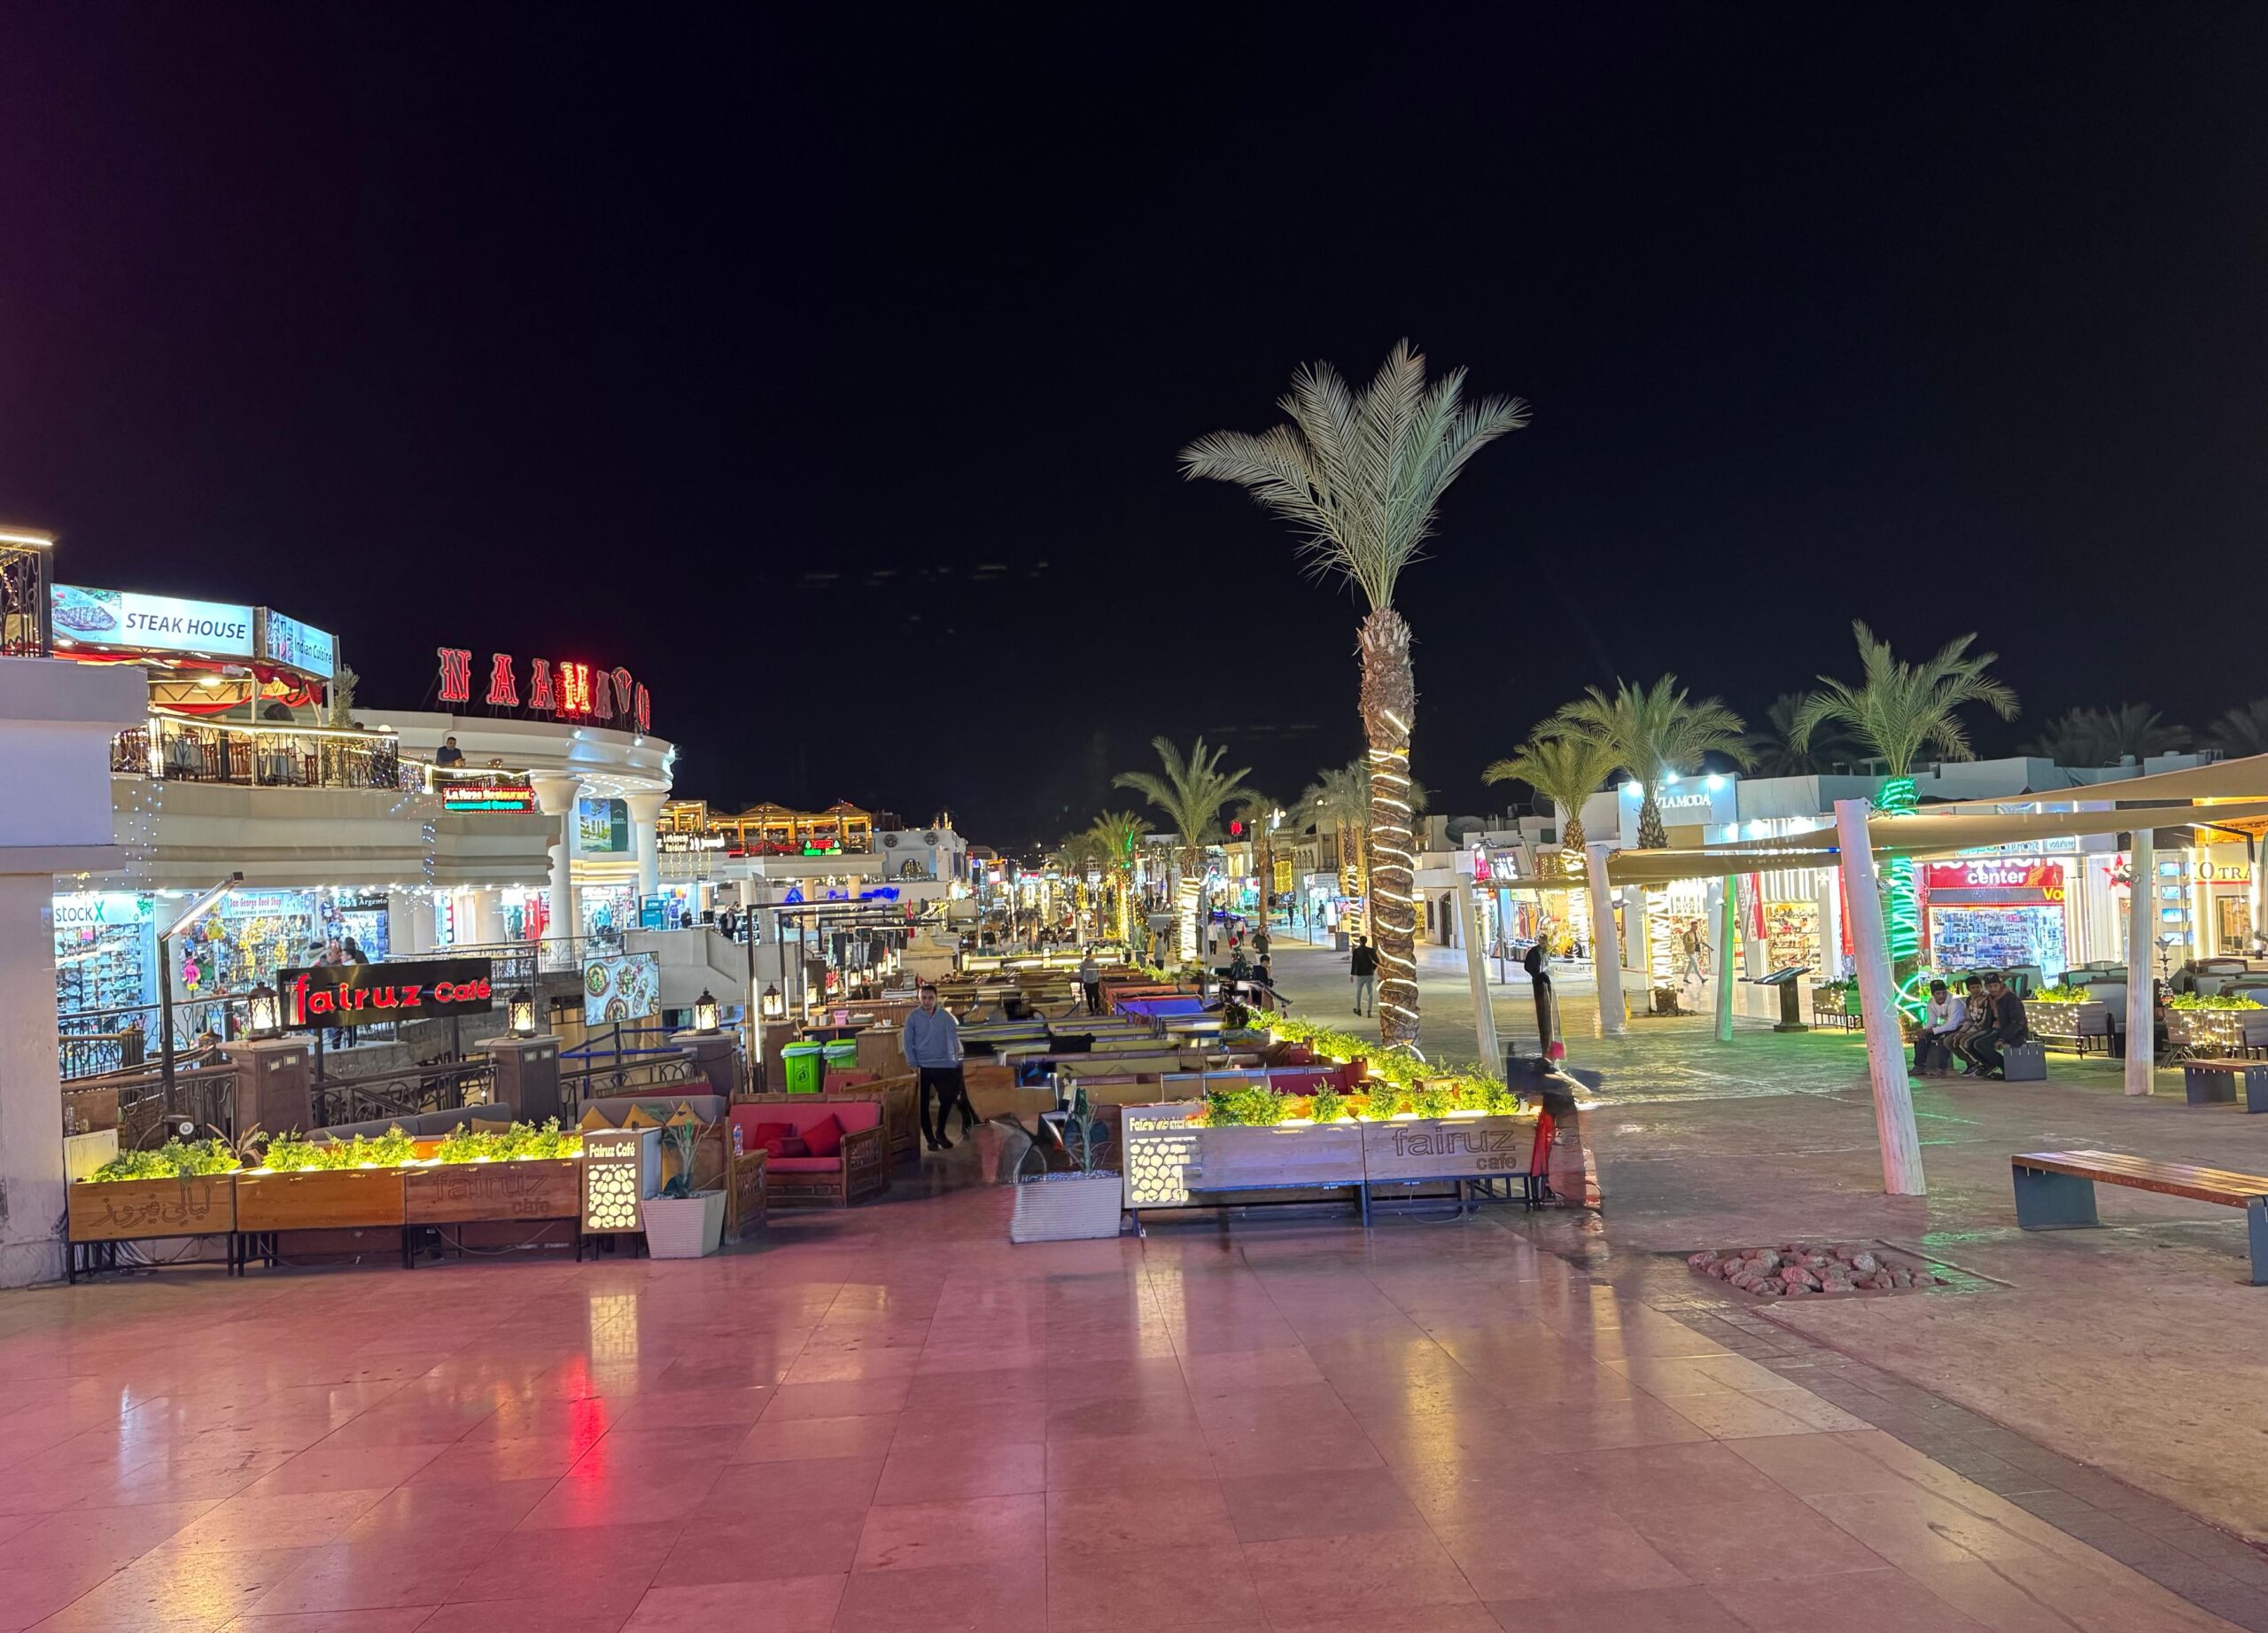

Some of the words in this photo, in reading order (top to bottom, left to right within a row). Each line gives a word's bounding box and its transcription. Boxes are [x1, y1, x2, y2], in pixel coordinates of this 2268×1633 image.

[126, 612, 183, 634] STEAK
[187, 618, 246, 640] HOUSE
[294, 636, 312, 657] Indian
[313, 644, 332, 665] Cuisine
[2048, 839, 2075, 849] vodafone
[1967, 868, 2027, 885] center
[295, 972, 423, 1025] fairuz
[434, 976, 492, 1003] Café
[588, 1142, 616, 1158] Fairuz
[616, 1140, 636, 1157] Café
[1391, 1126, 1517, 1157] fairuz
[432, 1170, 550, 1202] fairuz
[89, 1193, 160, 1229] فيروز
